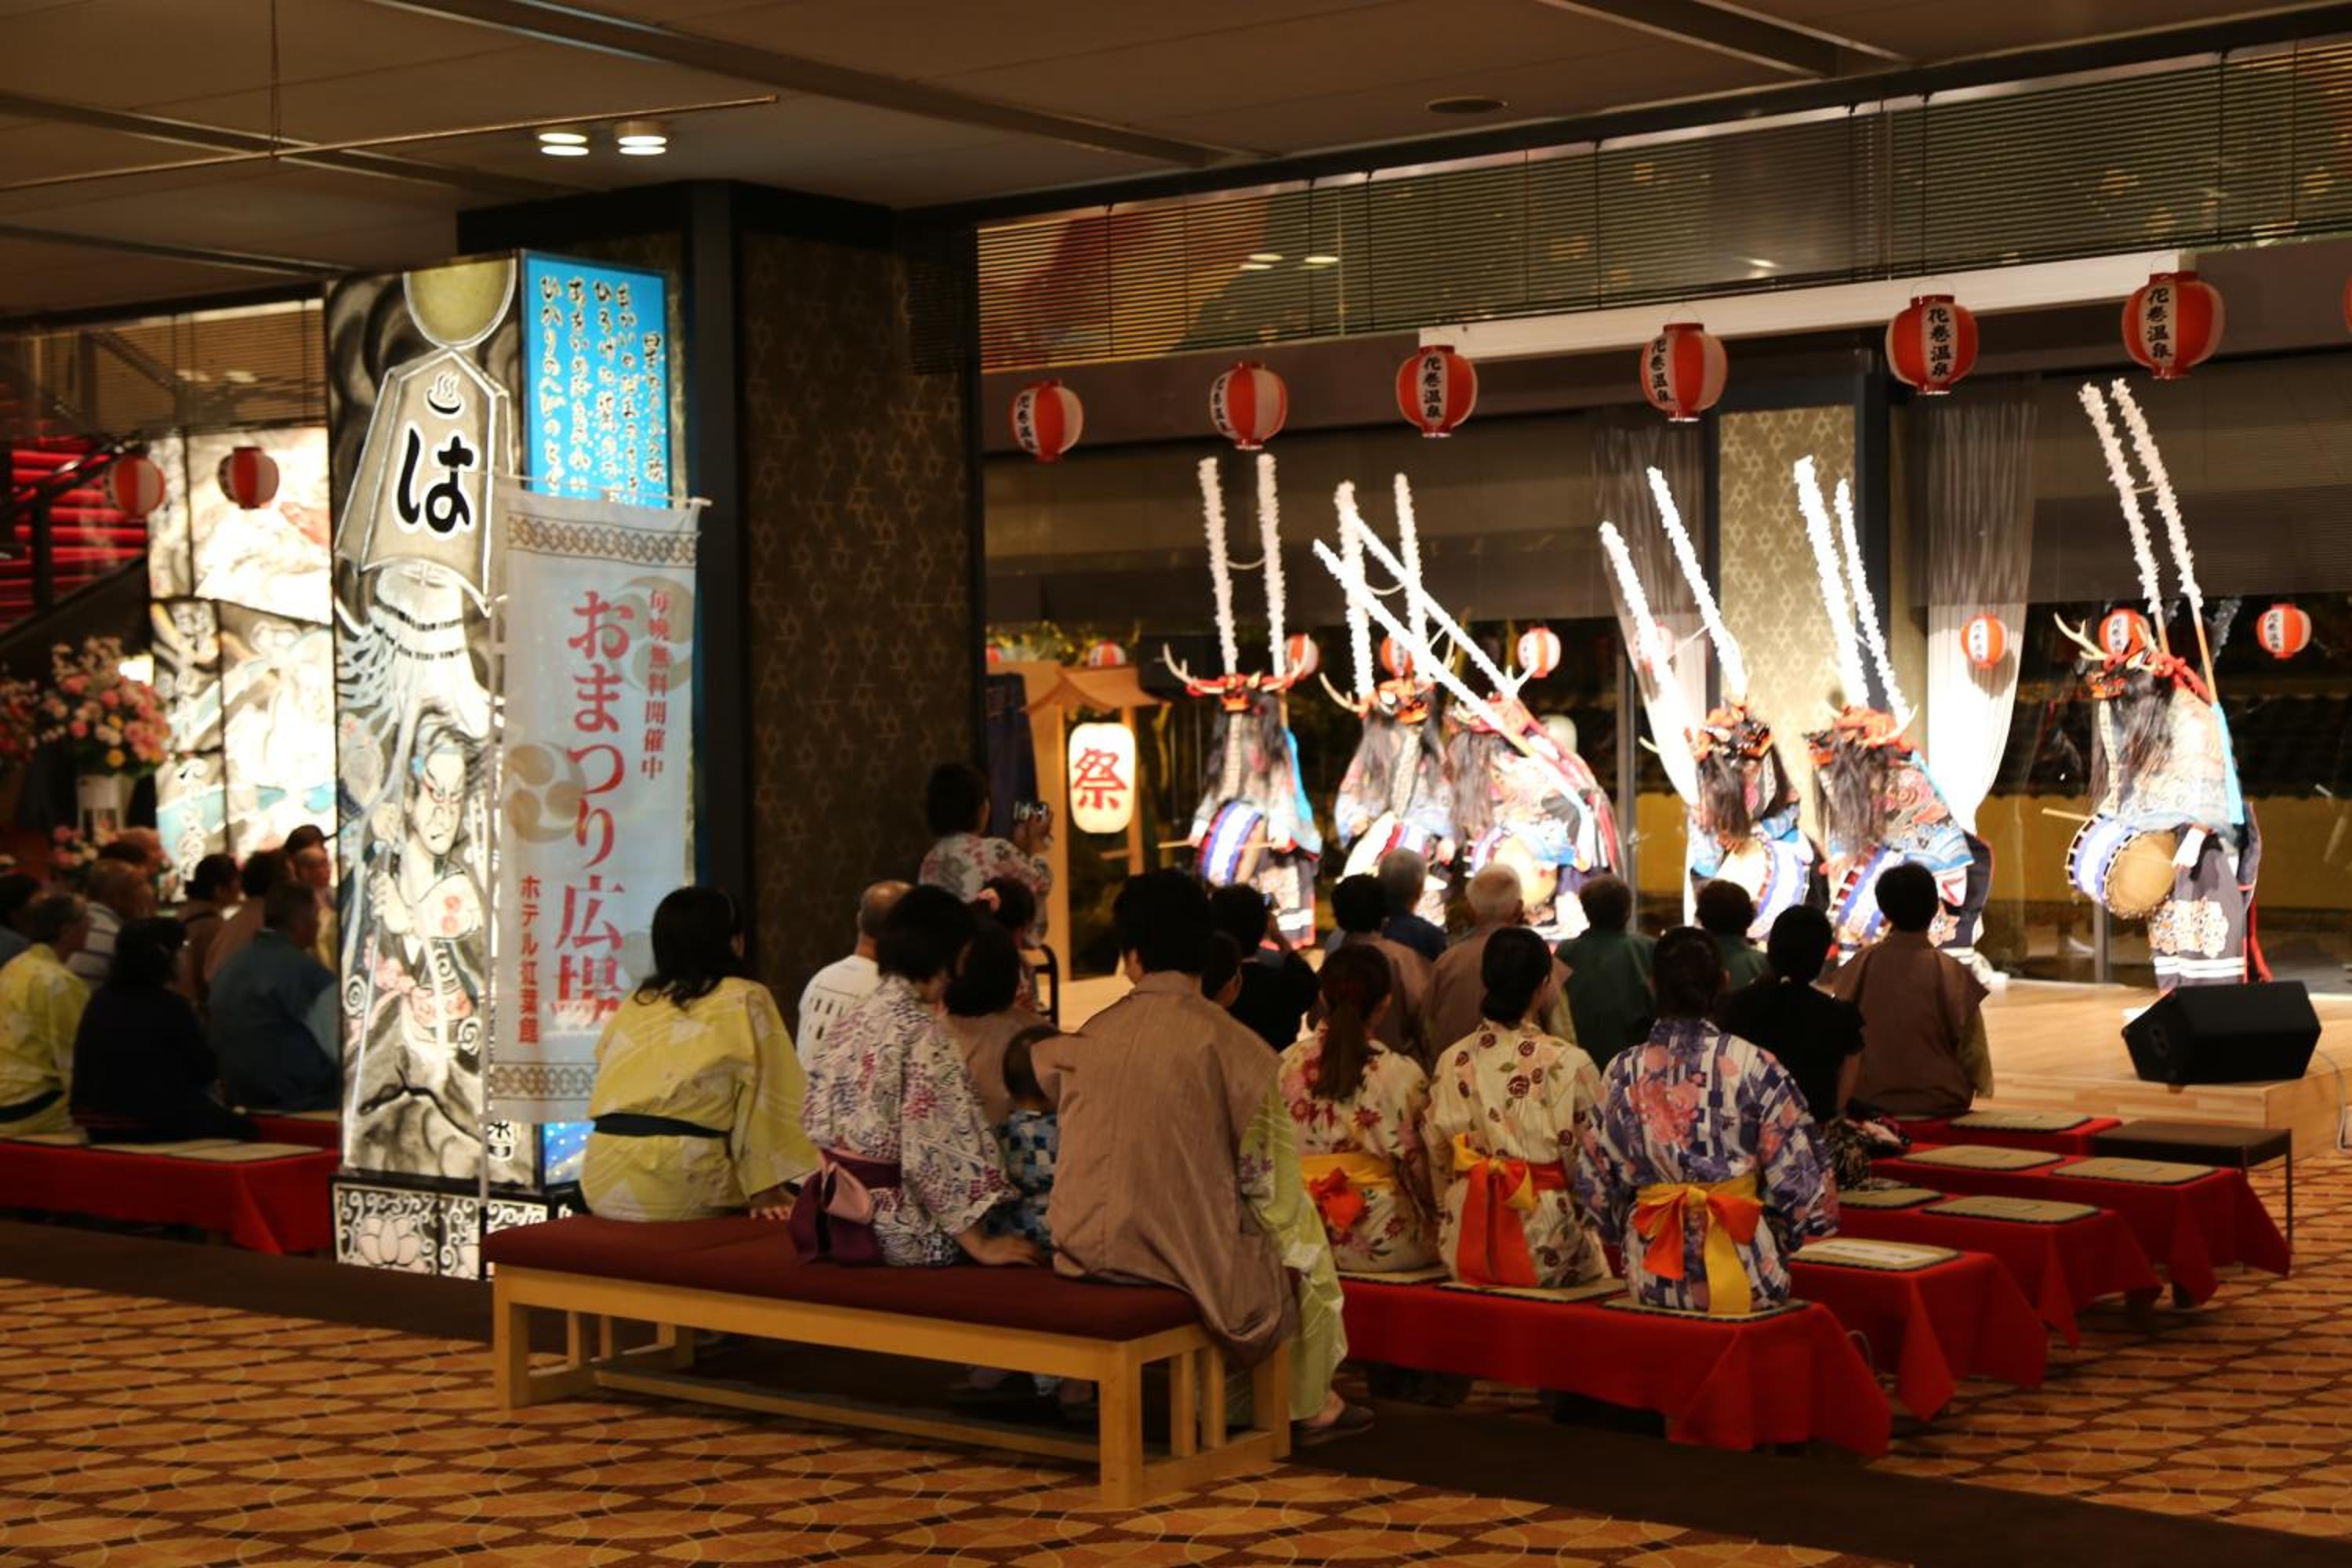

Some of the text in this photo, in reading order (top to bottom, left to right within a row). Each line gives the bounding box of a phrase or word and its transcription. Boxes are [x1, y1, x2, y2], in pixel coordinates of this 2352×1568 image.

[1928, 308, 1951, 377] 花巻温泉
[2147, 288, 2171, 358] 花巻温泉
[1423, 355, 1443, 418] 花巻温泉
[1651, 338, 1671, 401] 花巻温泉
[397, 427, 474, 533] は
[640, 589, 674, 781] 毎晩無料開催中
[553, 590, 634, 1022] おまつり広場
[1074, 748, 1127, 809] 祭
[518, 874, 541, 1046] ホテル紅葉館
